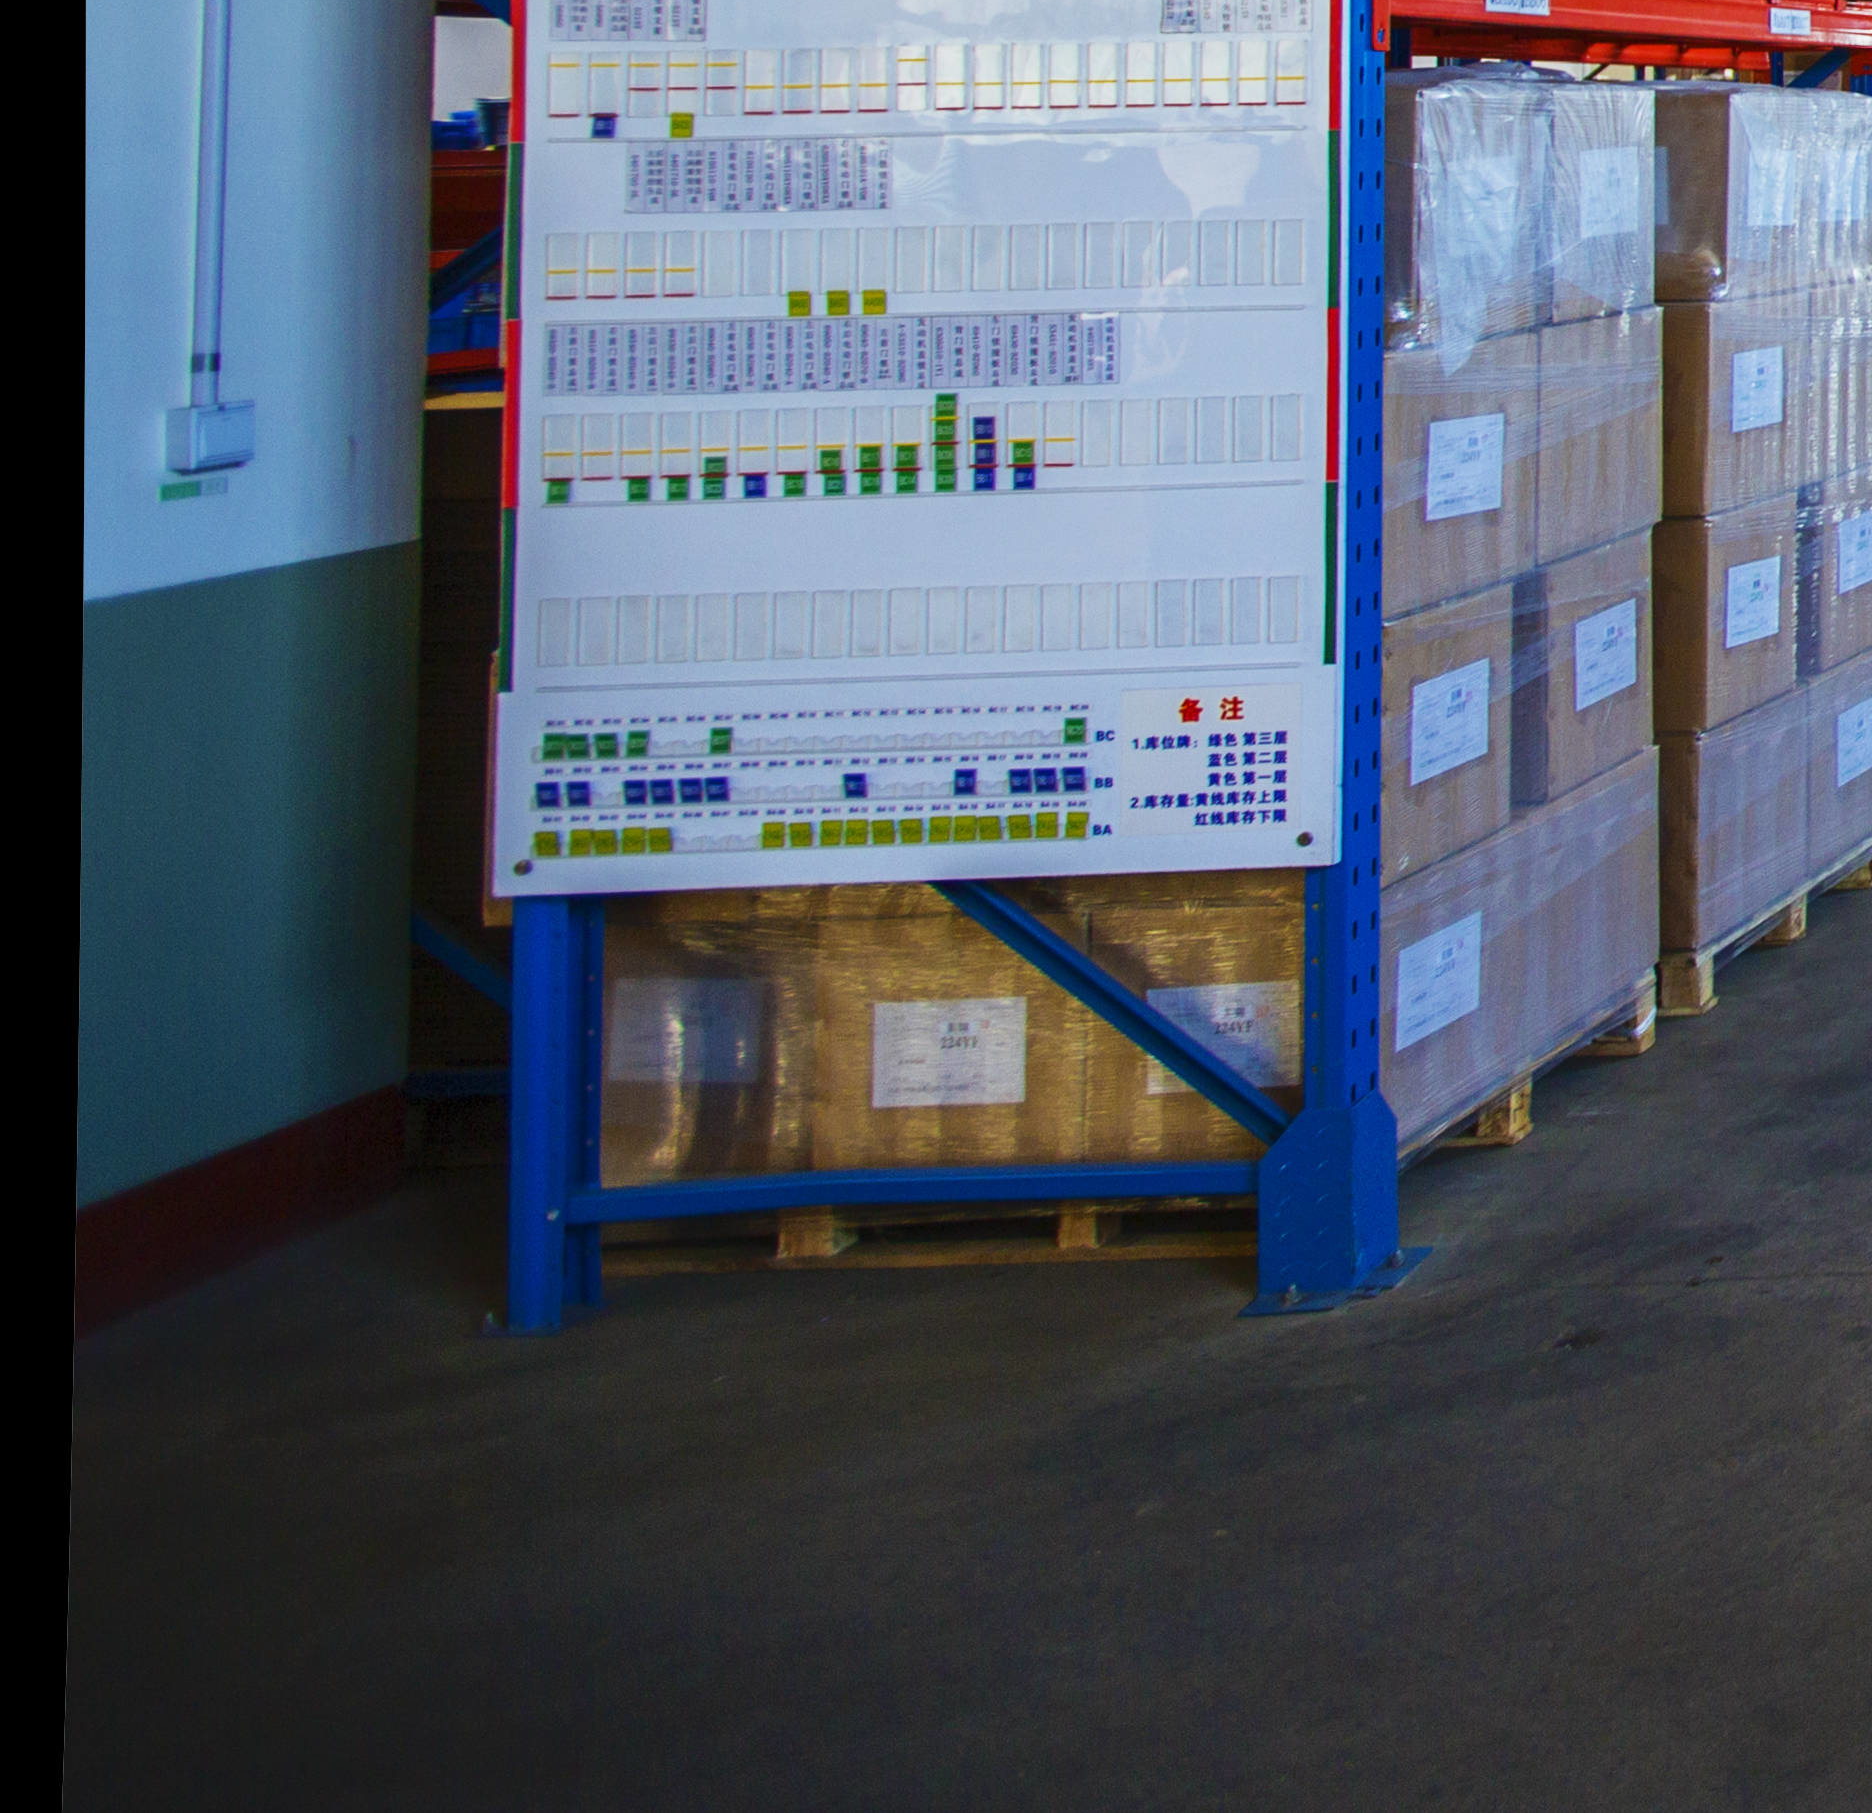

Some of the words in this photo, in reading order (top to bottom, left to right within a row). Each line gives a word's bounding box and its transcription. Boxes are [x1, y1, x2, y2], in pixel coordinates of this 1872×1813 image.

[1095, 730, 1116, 742] BC
[1094, 777, 1114, 789] BB
[1193, 808, 1288, 827] 红线库存下限
[1092, 824, 1113, 837] BA
